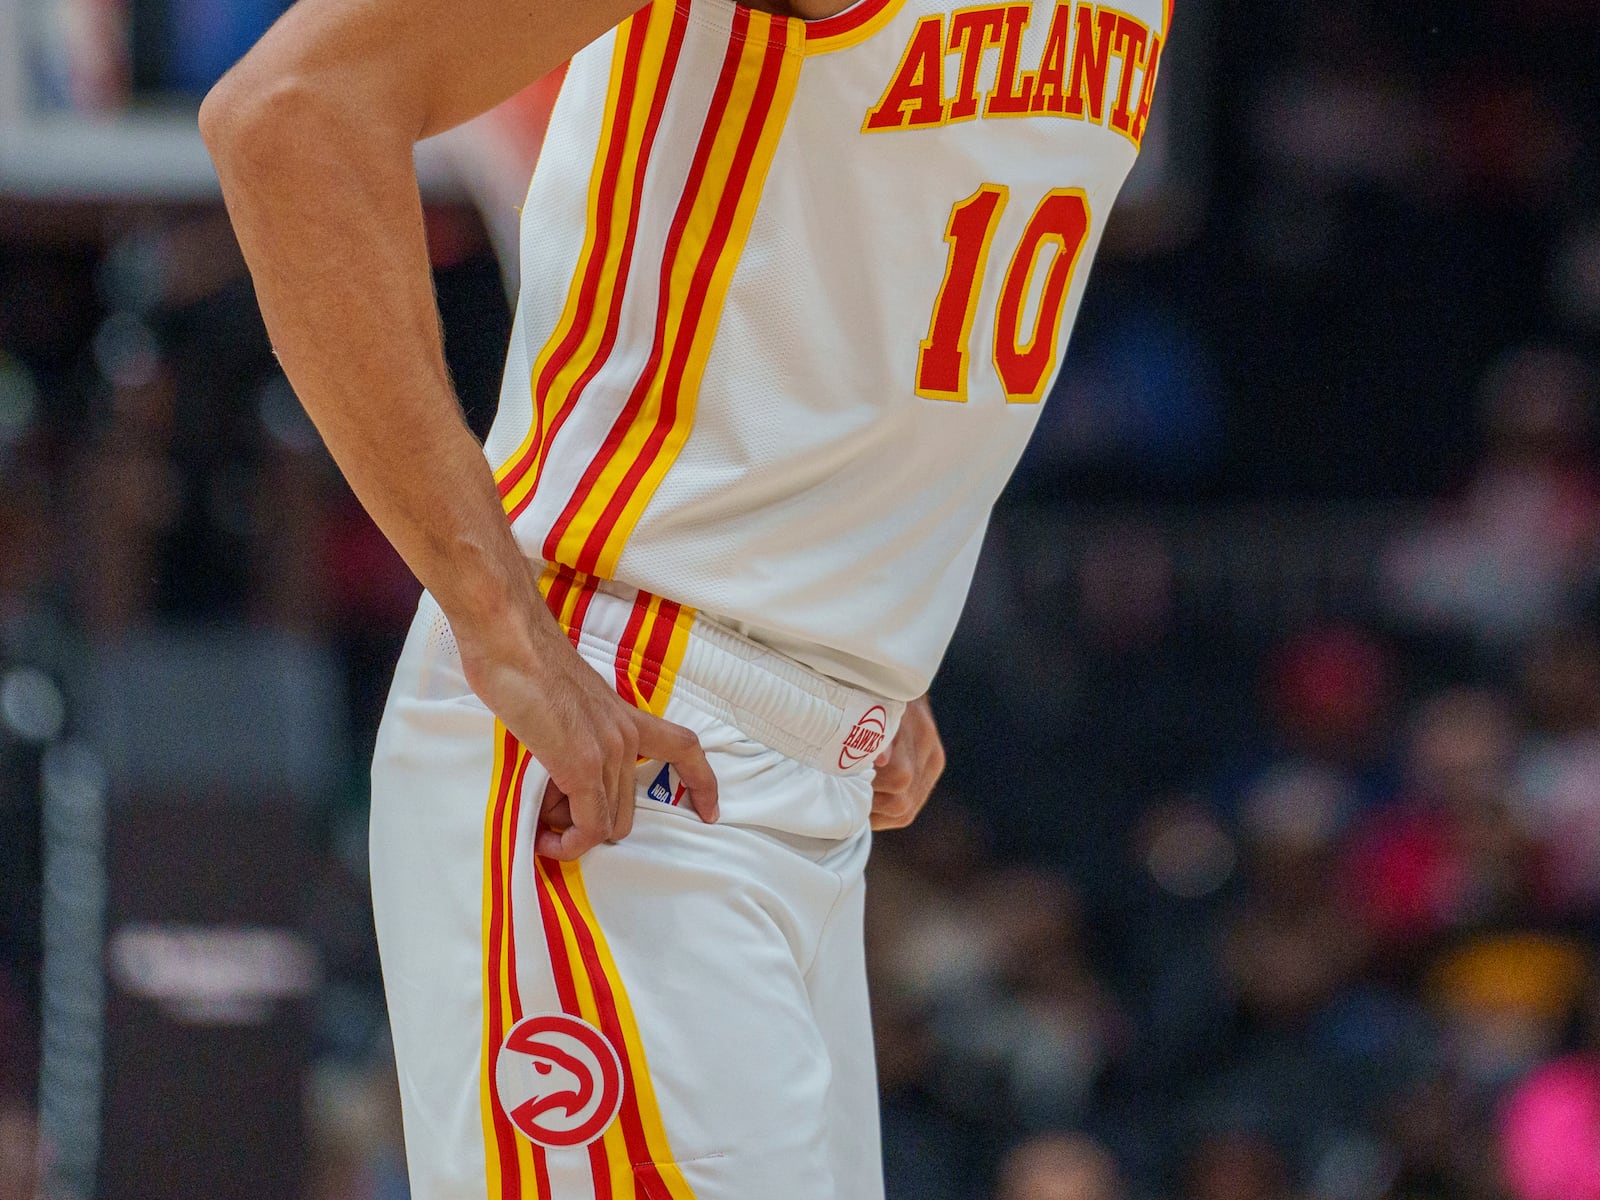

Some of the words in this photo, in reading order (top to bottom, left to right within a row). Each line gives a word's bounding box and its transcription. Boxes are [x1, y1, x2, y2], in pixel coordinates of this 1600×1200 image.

[860, 0, 1161, 152] ATLANTA
[915, 182, 1092, 404] 10
[842, 725, 885, 753] HAWKS
[650, 783, 670, 803] NBA
